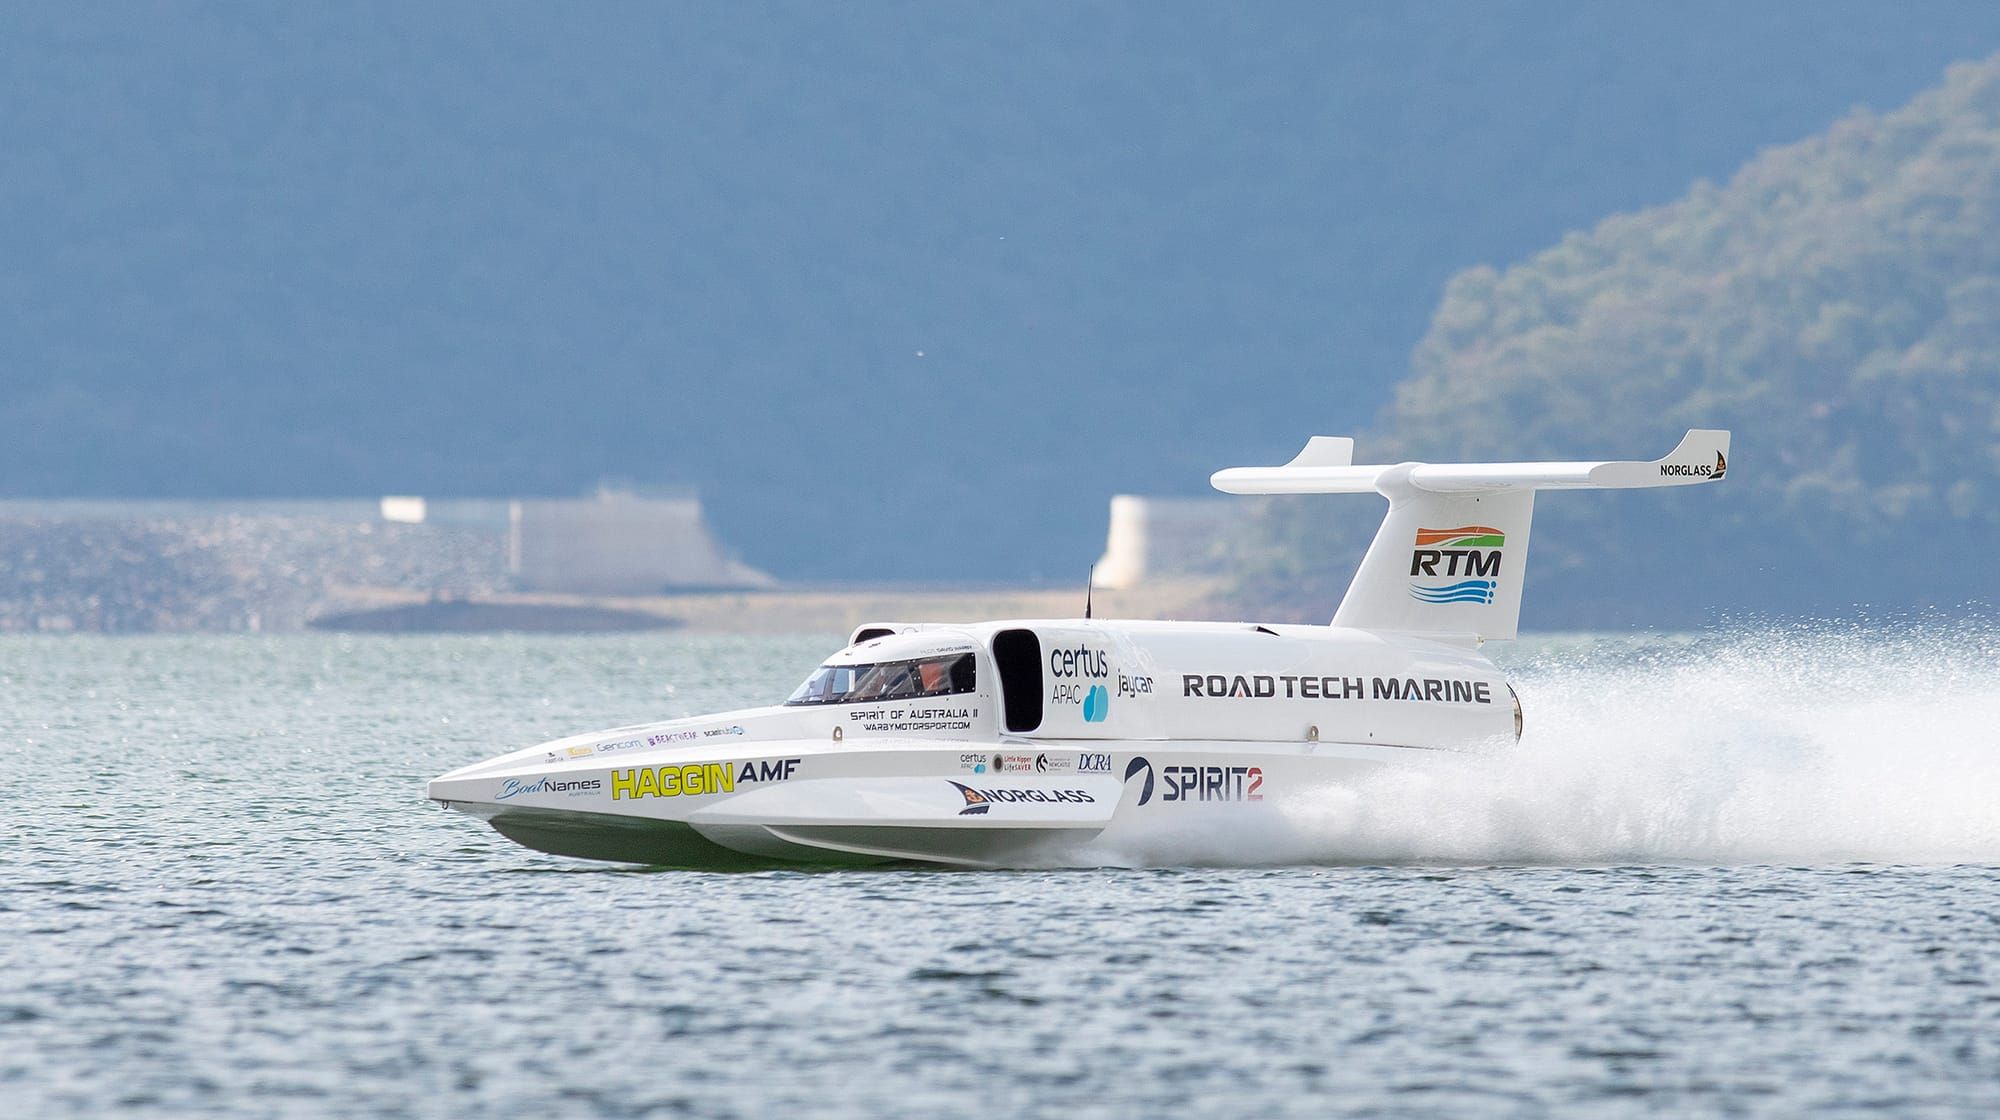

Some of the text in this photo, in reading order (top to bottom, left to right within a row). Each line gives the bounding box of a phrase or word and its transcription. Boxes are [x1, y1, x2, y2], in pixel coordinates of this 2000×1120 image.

[1661, 465, 1711, 476] NORGLASS
[1410, 549, 1502, 577] RTM
[1051, 643, 1108, 678] certus
[1117, 668, 1153, 698] jaycar
[1182, 674, 1491, 704] ROAD TECH MARINE
[1052, 684, 1081, 704] APAC
[850, 709, 978, 720] SPIRIT OF AUSTRALIA II
[864, 722, 971, 731] WARBYMOTORSPORT.COM
[960, 754, 987, 762] certus
[1017, 756, 1032, 764] Ripper
[1078, 753, 1112, 771] DCRA
[611, 759, 800, 800] HAGGIN AMF
[1163, 766, 1263, 801] SPIRIT2
[985, 789, 1096, 804] NORGLASS
